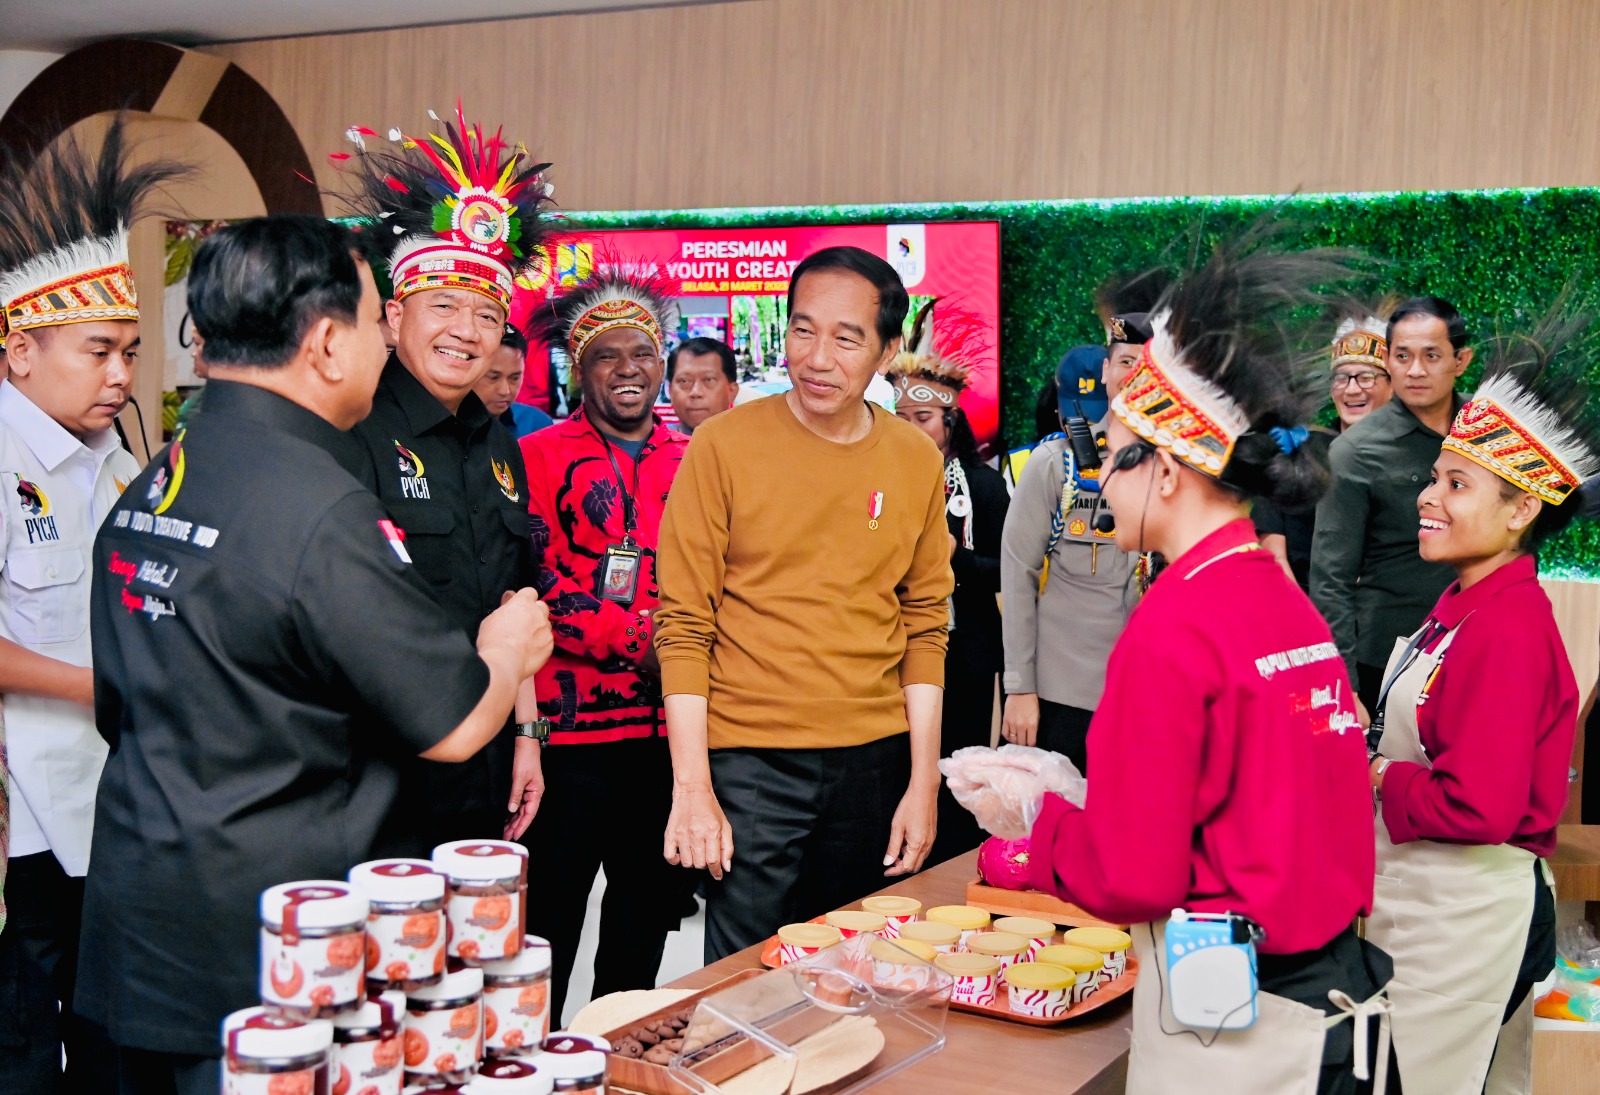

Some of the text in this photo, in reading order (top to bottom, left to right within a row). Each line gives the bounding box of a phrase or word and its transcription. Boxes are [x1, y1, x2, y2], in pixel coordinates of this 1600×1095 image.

[681, 240, 787, 259] PERESMIAN
[664, 261, 729, 279] YOUTH
[681, 281, 718, 292] SELASA,
[719, 281, 729, 291] 21
[730, 281, 763, 291] MARET
[400, 476, 430, 499] PYCH
[25, 515, 59, 544] PYCH
